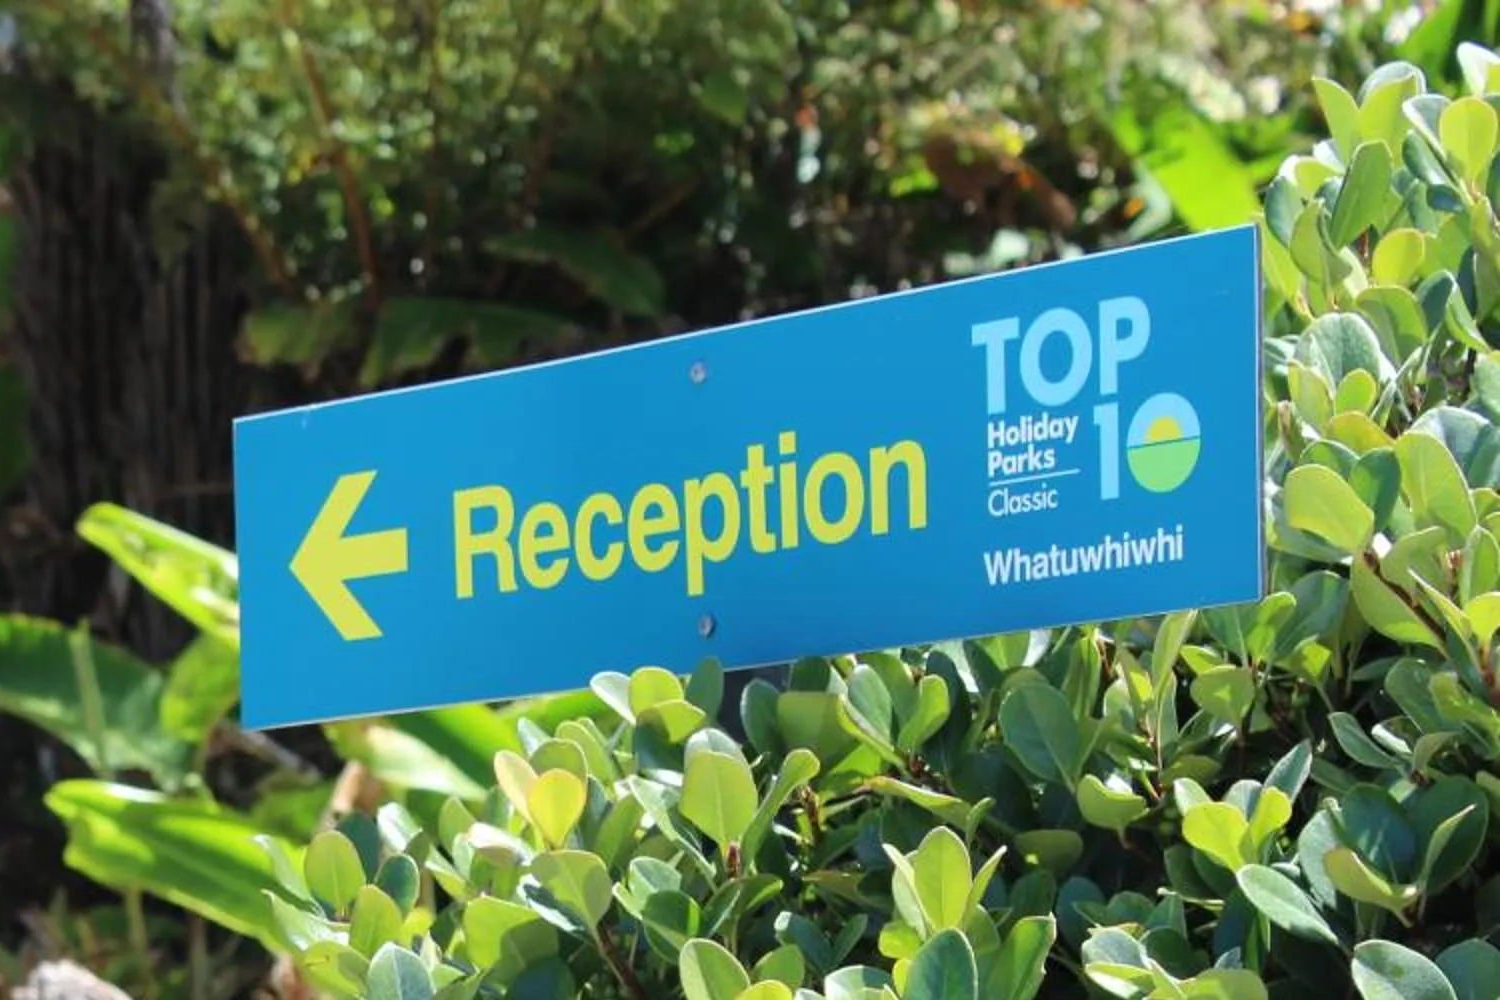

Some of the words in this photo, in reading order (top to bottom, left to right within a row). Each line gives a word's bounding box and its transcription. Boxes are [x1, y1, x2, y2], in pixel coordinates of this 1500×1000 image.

[971, 295, 1151, 416] TOP
[987, 411, 1079, 449] Holiday
[987, 444, 1056, 478] Parks
[1093, 391, 1201, 501] 10
[452, 430, 928, 599] Reception
[987, 482, 1059, 518] Classic
[983, 523, 1184, 586] Whatuwhiwhi
